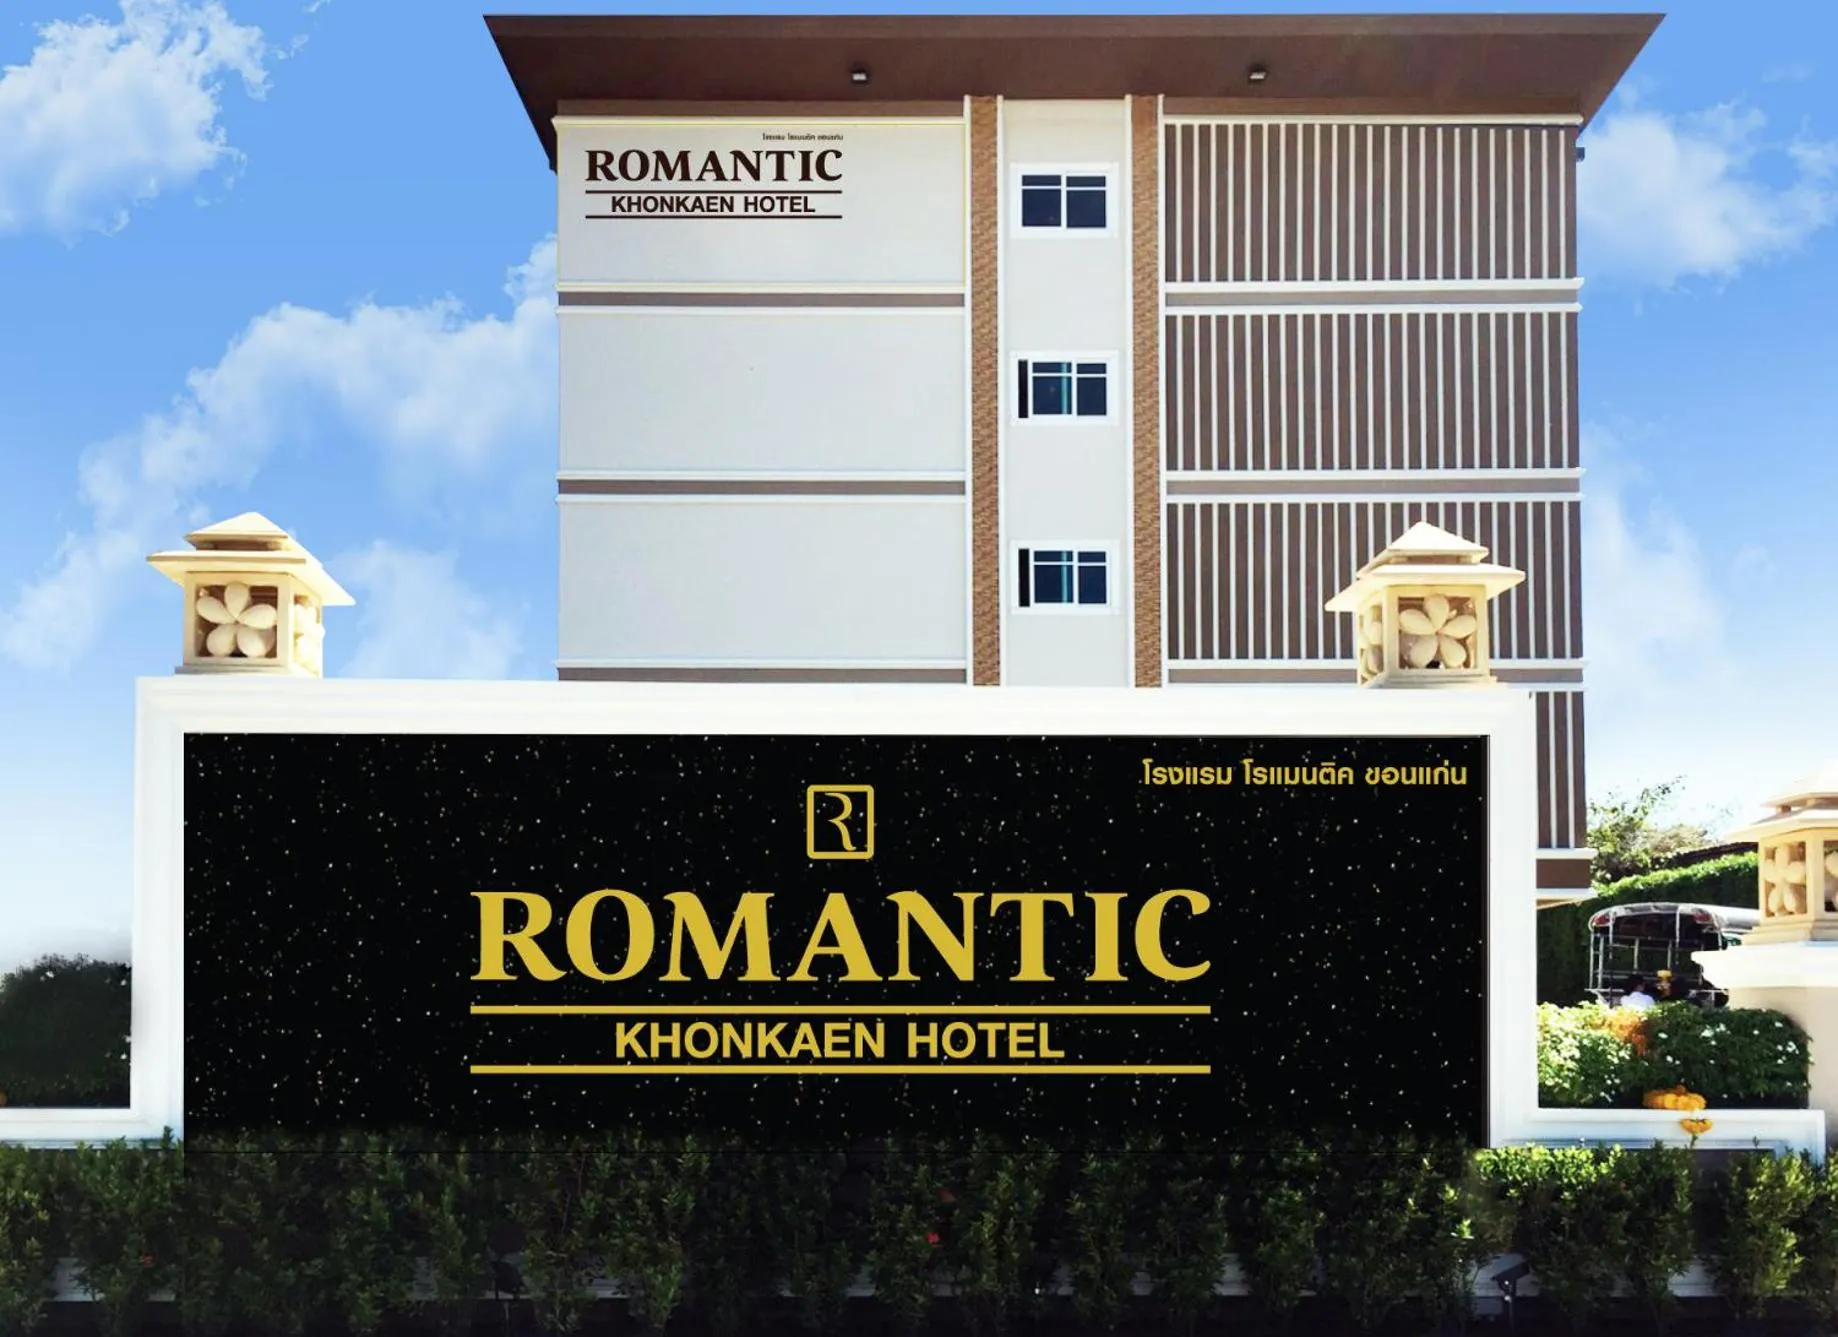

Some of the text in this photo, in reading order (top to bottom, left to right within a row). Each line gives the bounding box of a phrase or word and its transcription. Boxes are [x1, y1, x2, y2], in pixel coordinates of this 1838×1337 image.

[586, 149, 843, 182] ROMANTIC
[612, 196, 816, 213] KHONKAEN HOTEL
[1142, 758, 1467, 785] โรงแรม โรแมนติค ขอนแก่น
[471, 888, 1211, 982] ROMANTIC
[615, 1022, 1065, 1059] KHONKAEN HOTEL
